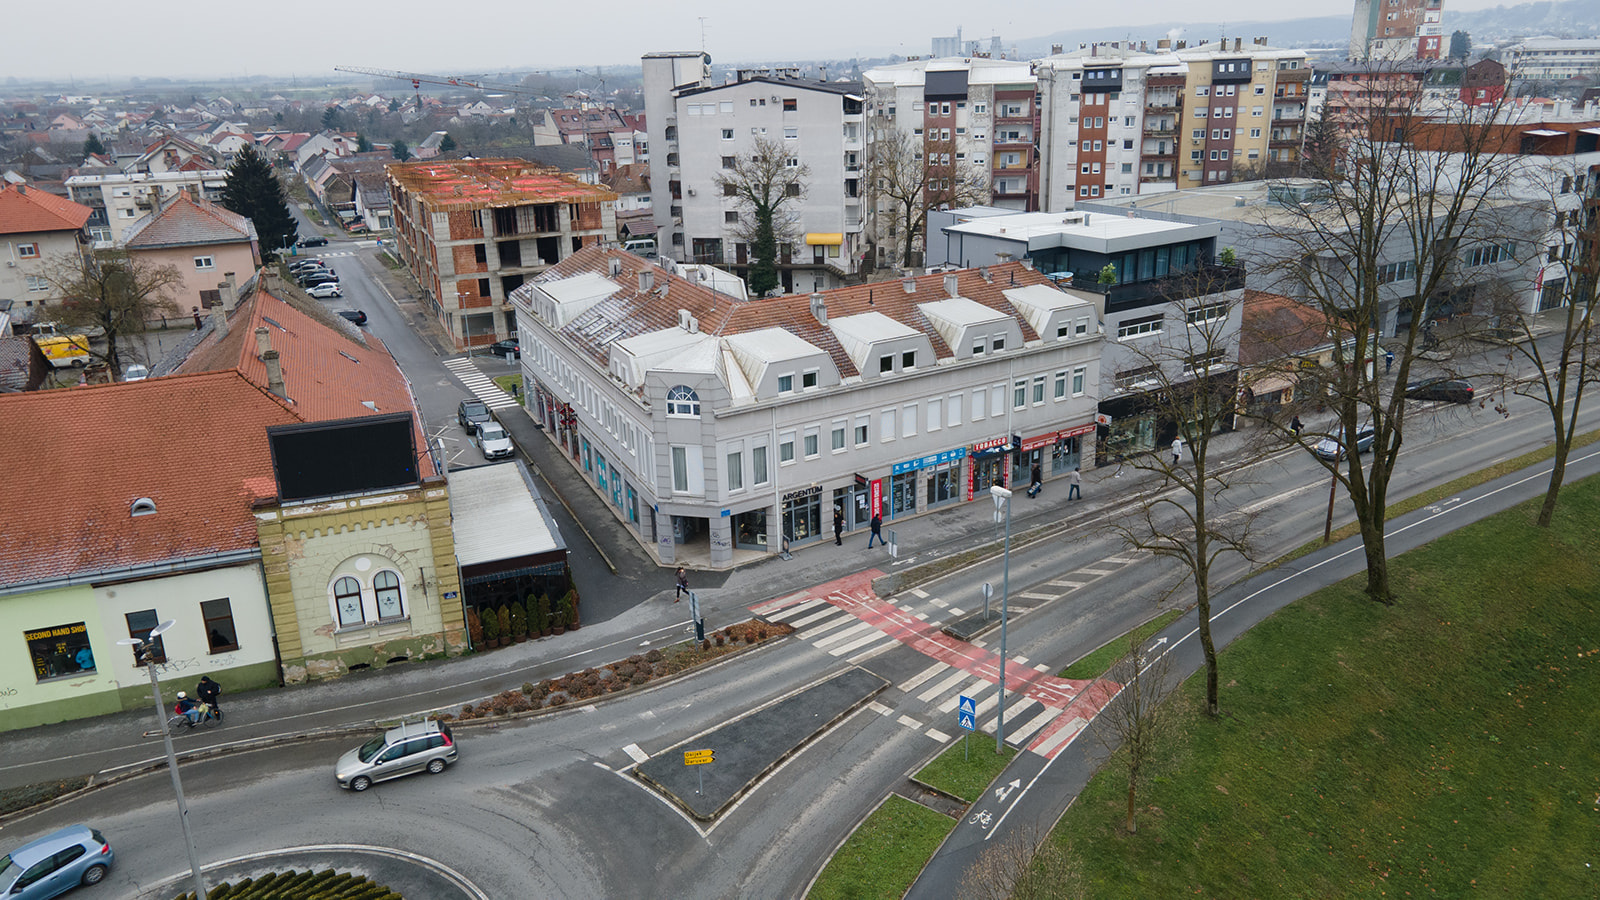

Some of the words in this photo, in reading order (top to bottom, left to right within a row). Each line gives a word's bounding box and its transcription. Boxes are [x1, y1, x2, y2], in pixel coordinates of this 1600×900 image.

[975, 437, 1006, 451] TOBACCO
[782, 485, 823, 502] ARGENTUM
[25, 630, 52, 641] SECOND
[52, 627, 71, 637] HAND
